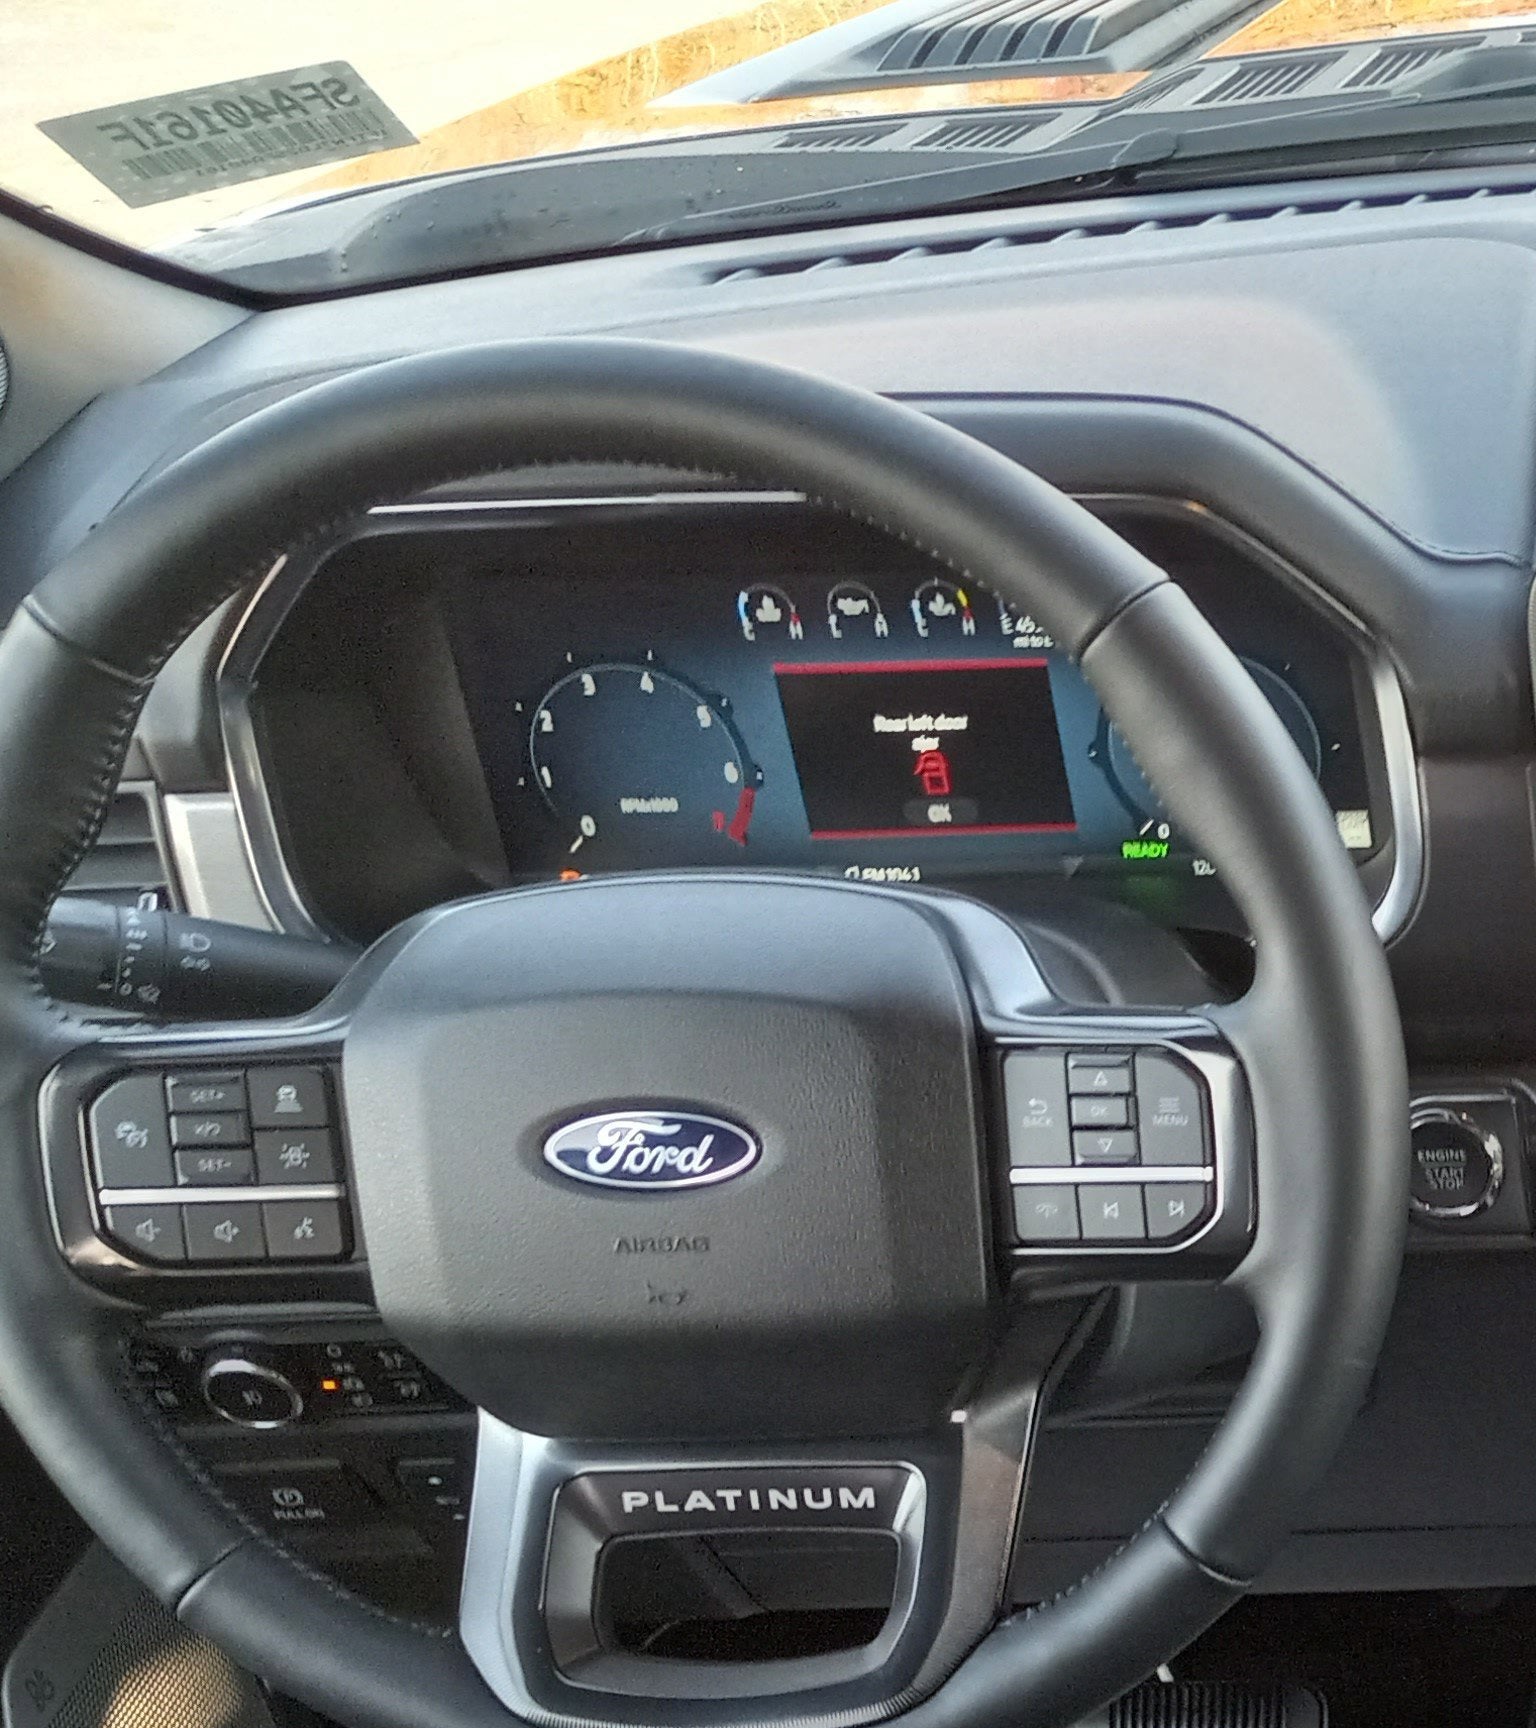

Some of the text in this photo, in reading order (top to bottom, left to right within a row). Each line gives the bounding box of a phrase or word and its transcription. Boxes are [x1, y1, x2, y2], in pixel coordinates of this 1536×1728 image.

[1122, 841, 1168, 858] READY
[1152, 1115, 1188, 1126] MENU
[586, 1120, 714, 1175] Ford
[1417, 1149, 1466, 1162] ENGINE
[621, 1487, 876, 1513] PLATINUM
